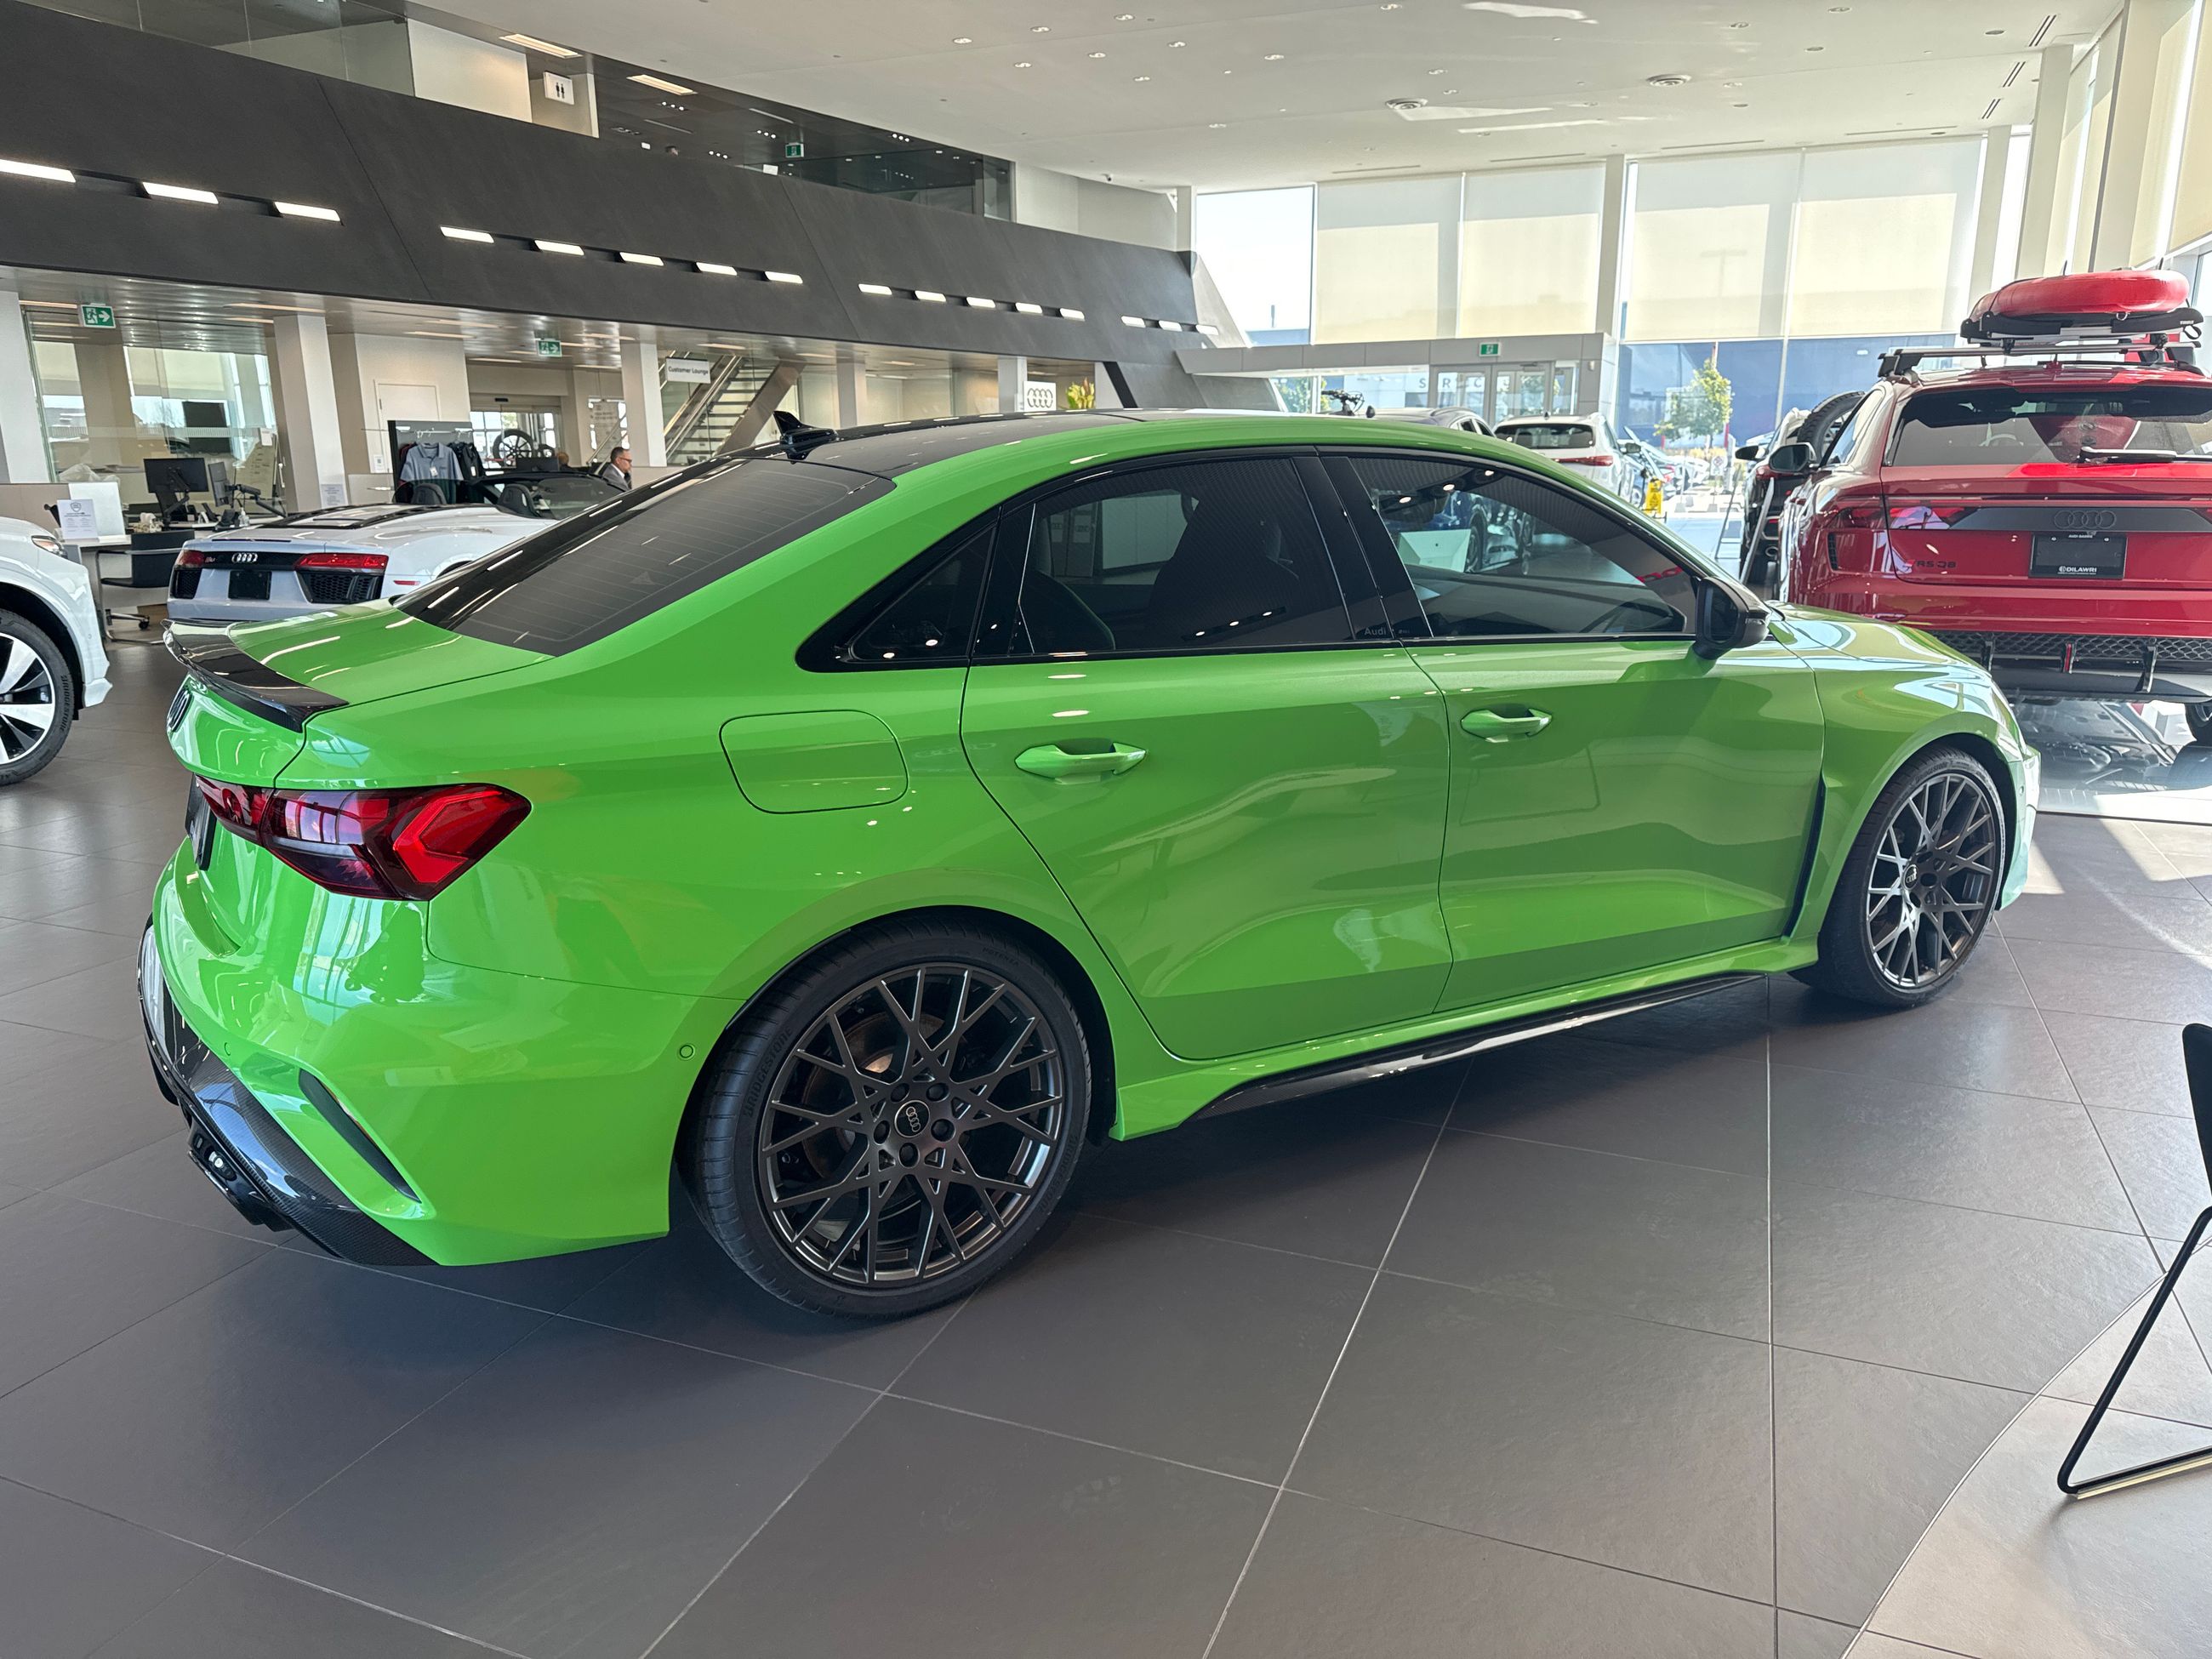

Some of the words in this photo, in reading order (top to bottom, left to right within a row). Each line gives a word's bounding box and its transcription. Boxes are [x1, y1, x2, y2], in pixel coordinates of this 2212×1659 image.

[692, 368, 709, 376] Lounge
[1936, 561, 1957, 569] Q8
[1364, 626, 1387, 636] Audi
[744, 1027, 792, 1117] BRIDGESTONE
